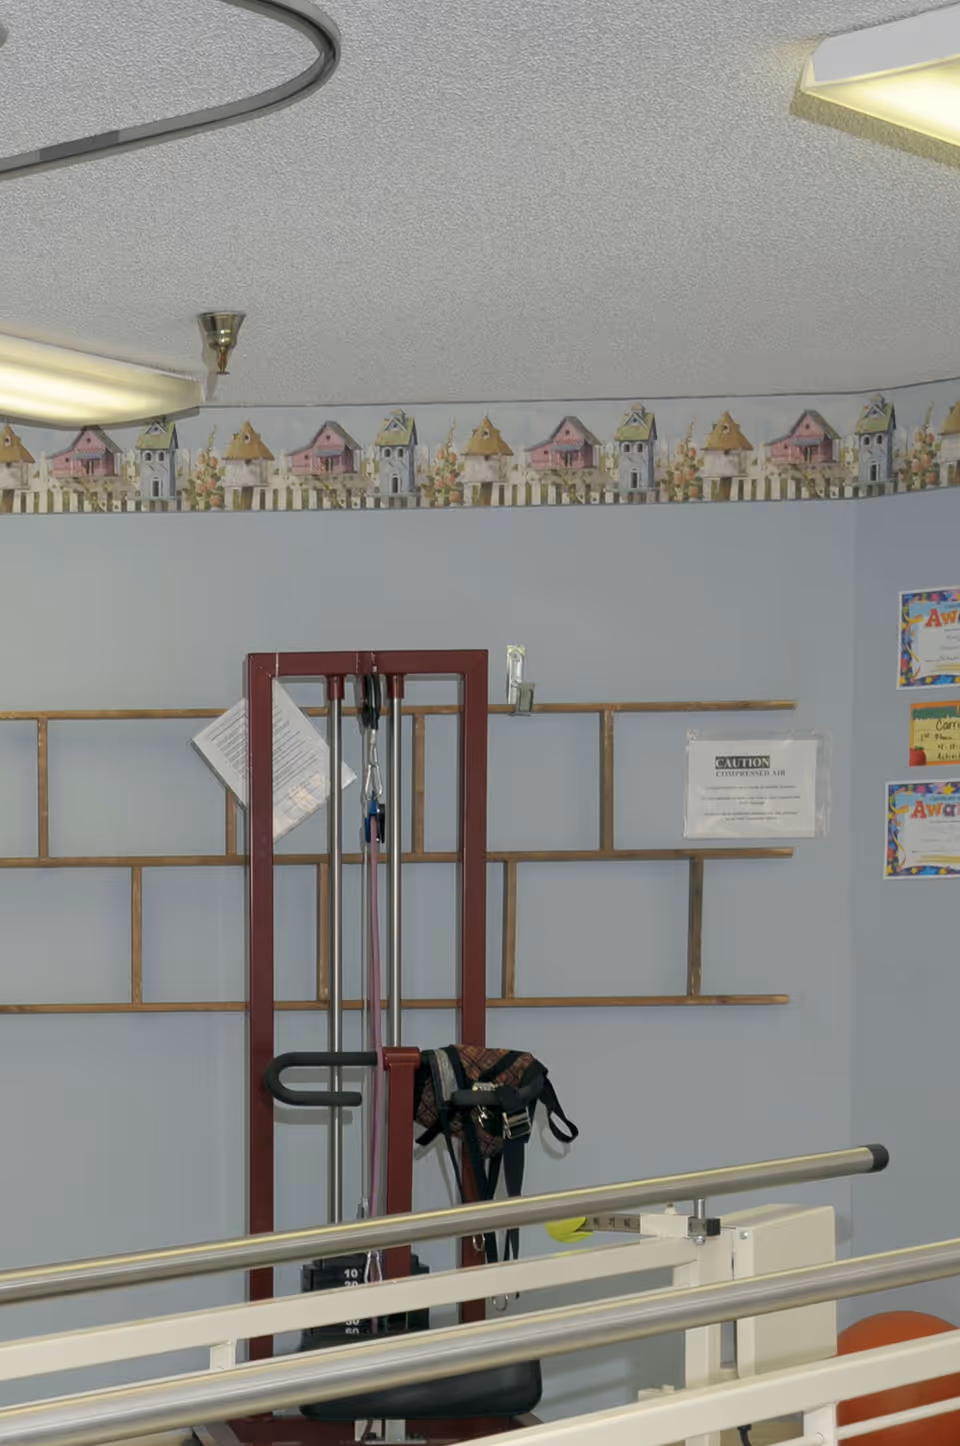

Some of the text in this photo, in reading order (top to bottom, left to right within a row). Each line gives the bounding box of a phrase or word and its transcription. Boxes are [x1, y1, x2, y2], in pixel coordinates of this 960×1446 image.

[925, 608, 960, 627] Aw
[715, 757, 770, 769] CAUTION
[716, 769, 785, 777] COMPRESSED AIR
[344, 1268, 358, 1279] 10
